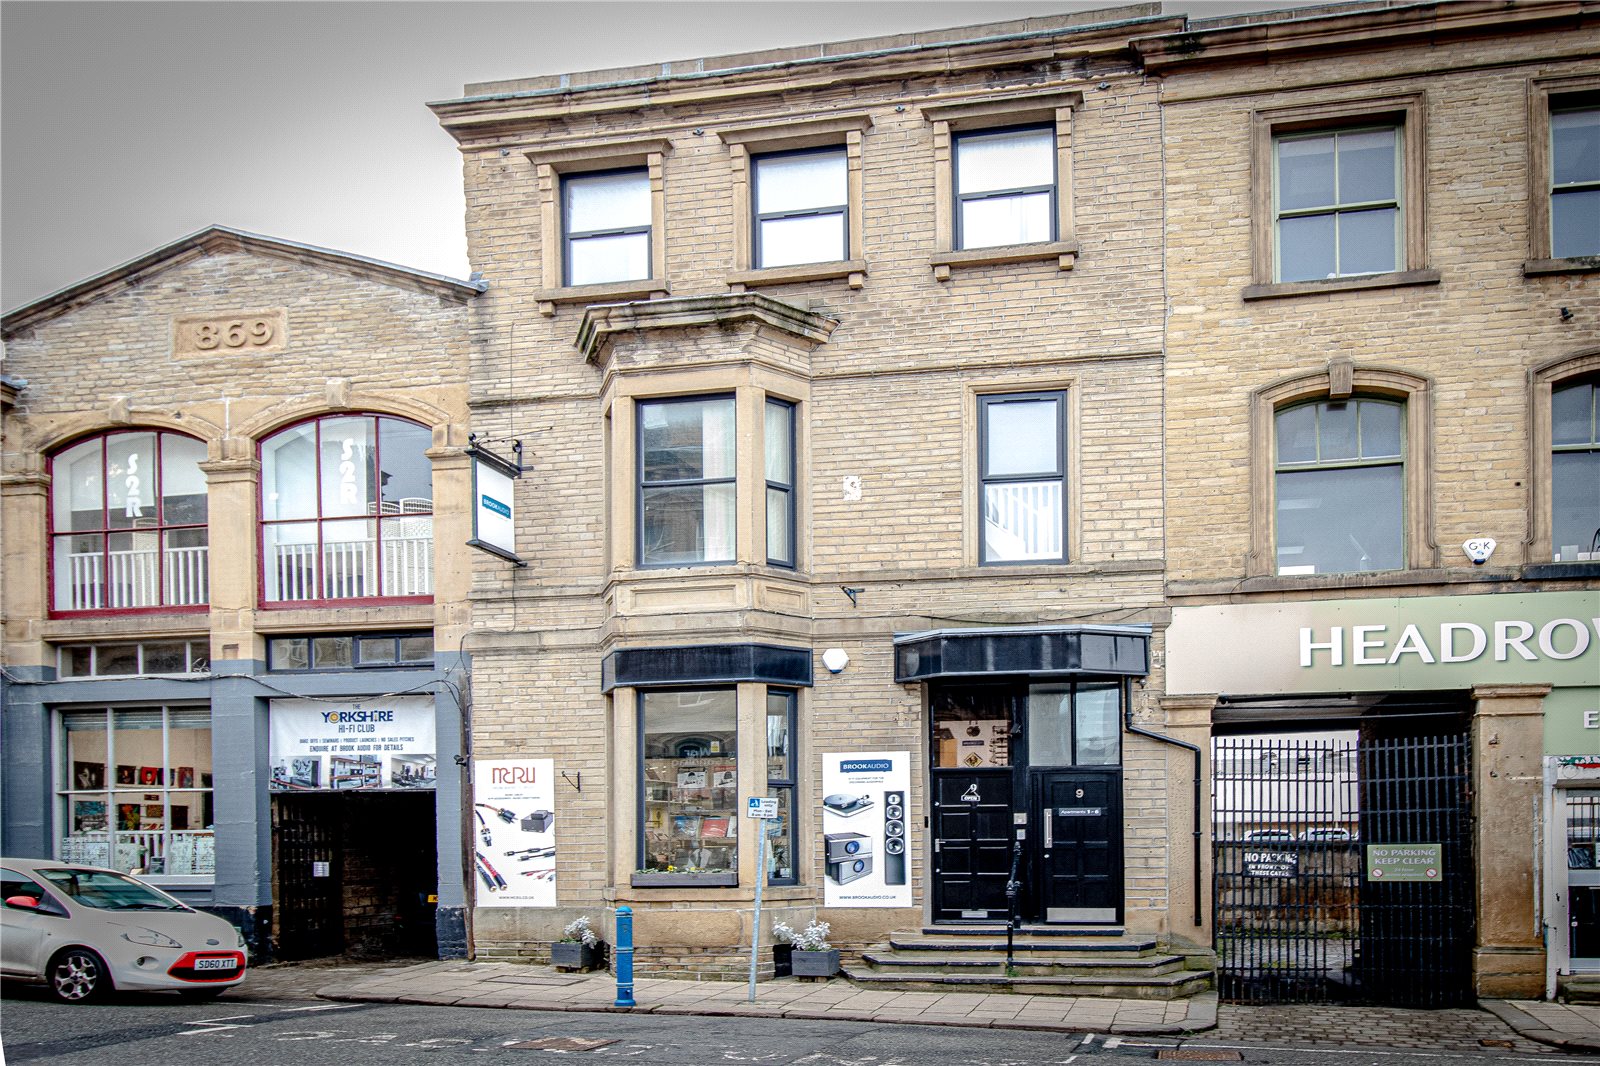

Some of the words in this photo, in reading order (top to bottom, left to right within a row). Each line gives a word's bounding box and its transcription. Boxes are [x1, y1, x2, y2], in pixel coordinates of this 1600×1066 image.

[194, 319, 274, 351] 869
[340, 438, 358, 505] S2R
[125, 453, 143, 518] S2R
[1300, 617, 1600, 667] HEADRO
[321, 710, 394, 724] YORKSHIRE
[338, 724, 356, 733] HI-FI
[357, 723, 376, 733] CLUB
[339, 744, 355, 752] BROOK
[1075, 788, 1084, 799] 9
[1244, 852, 1259, 862] NO
[1391, 848, 1437, 856] PARKING
[1402, 857, 1434, 865] CLEAR
[198, 960, 220, 969] SD60
[220, 959, 236, 968] XTT
